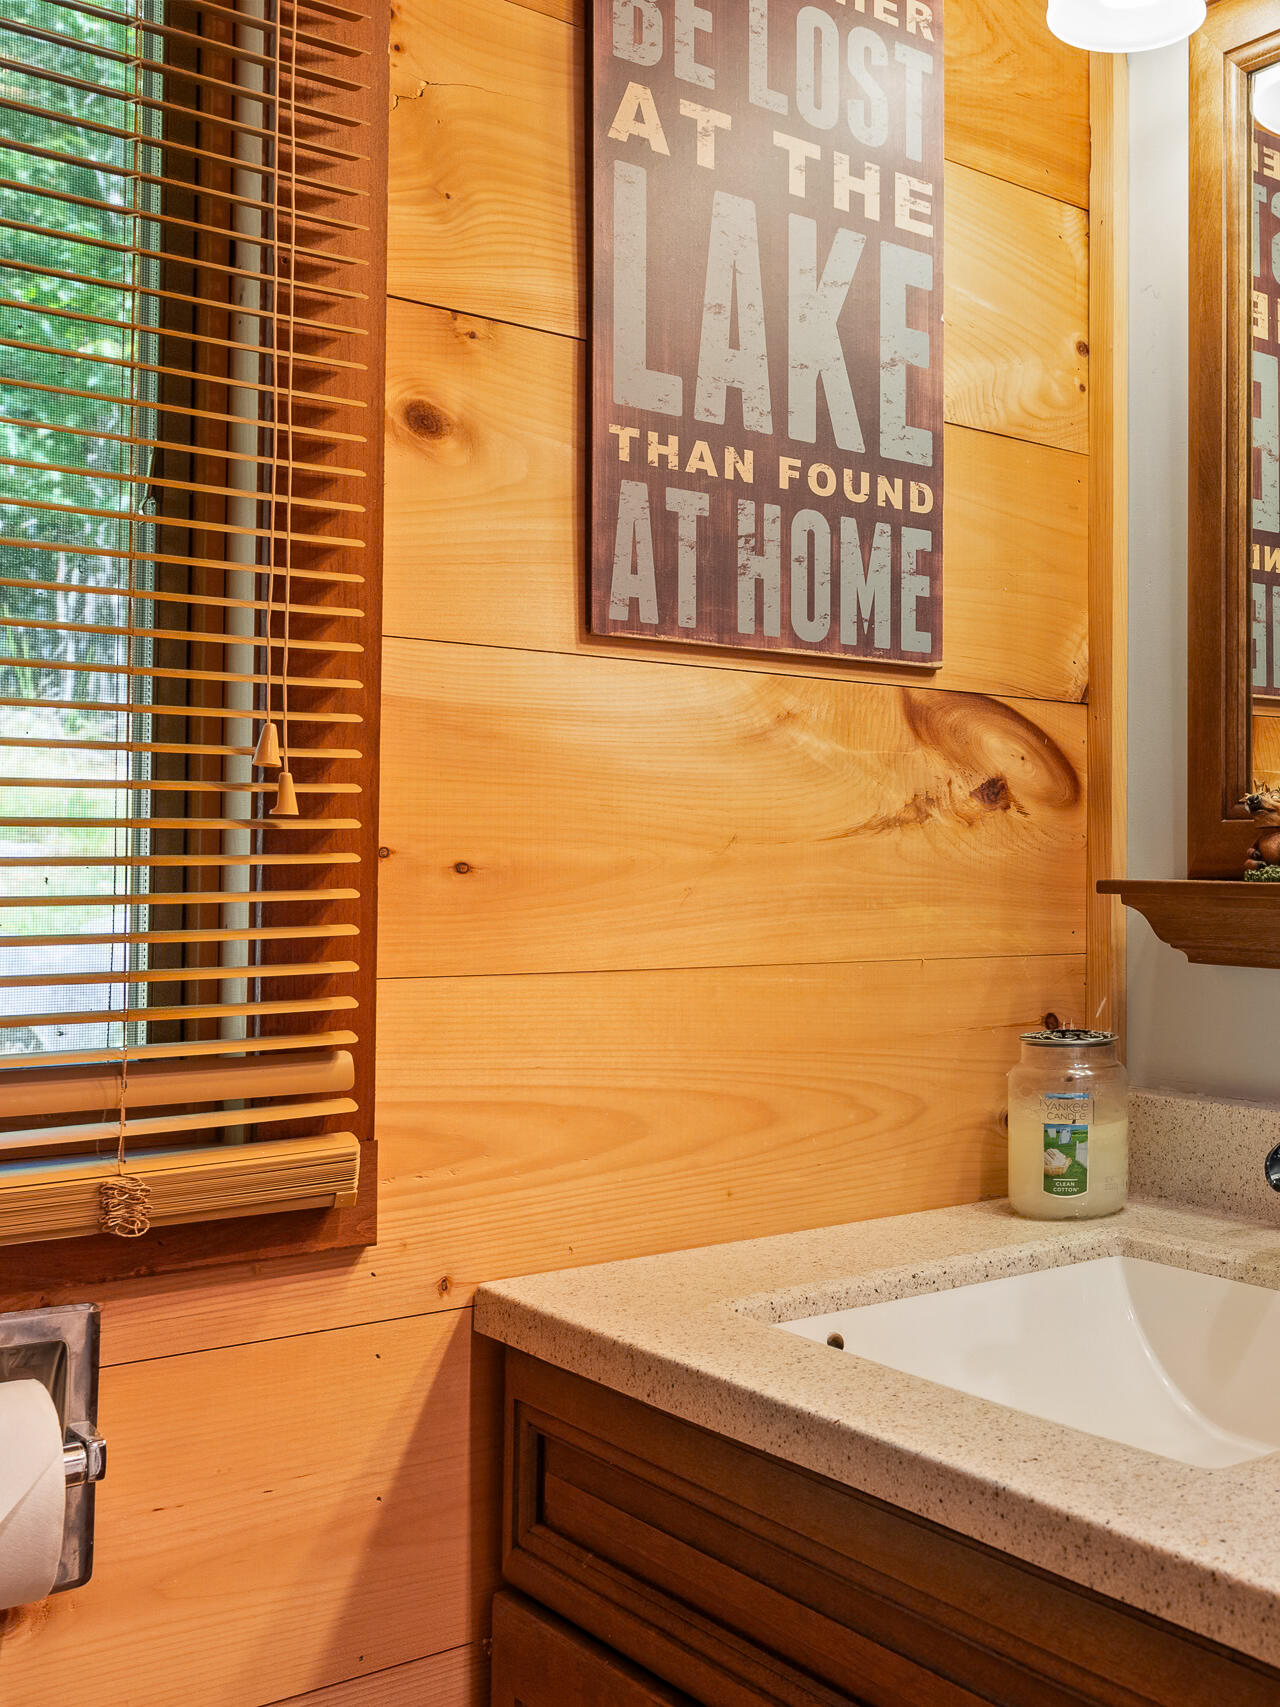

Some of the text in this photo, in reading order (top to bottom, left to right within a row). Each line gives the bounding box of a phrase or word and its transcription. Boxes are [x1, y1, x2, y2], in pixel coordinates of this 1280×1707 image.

[607, 81, 934, 238] AT THE
[748, 0, 934, 163] LOST
[612, 159, 933, 467] LAKE
[608, 423, 934, 514] THAN FOUND
[608, 479, 933, 654] AT HOME
